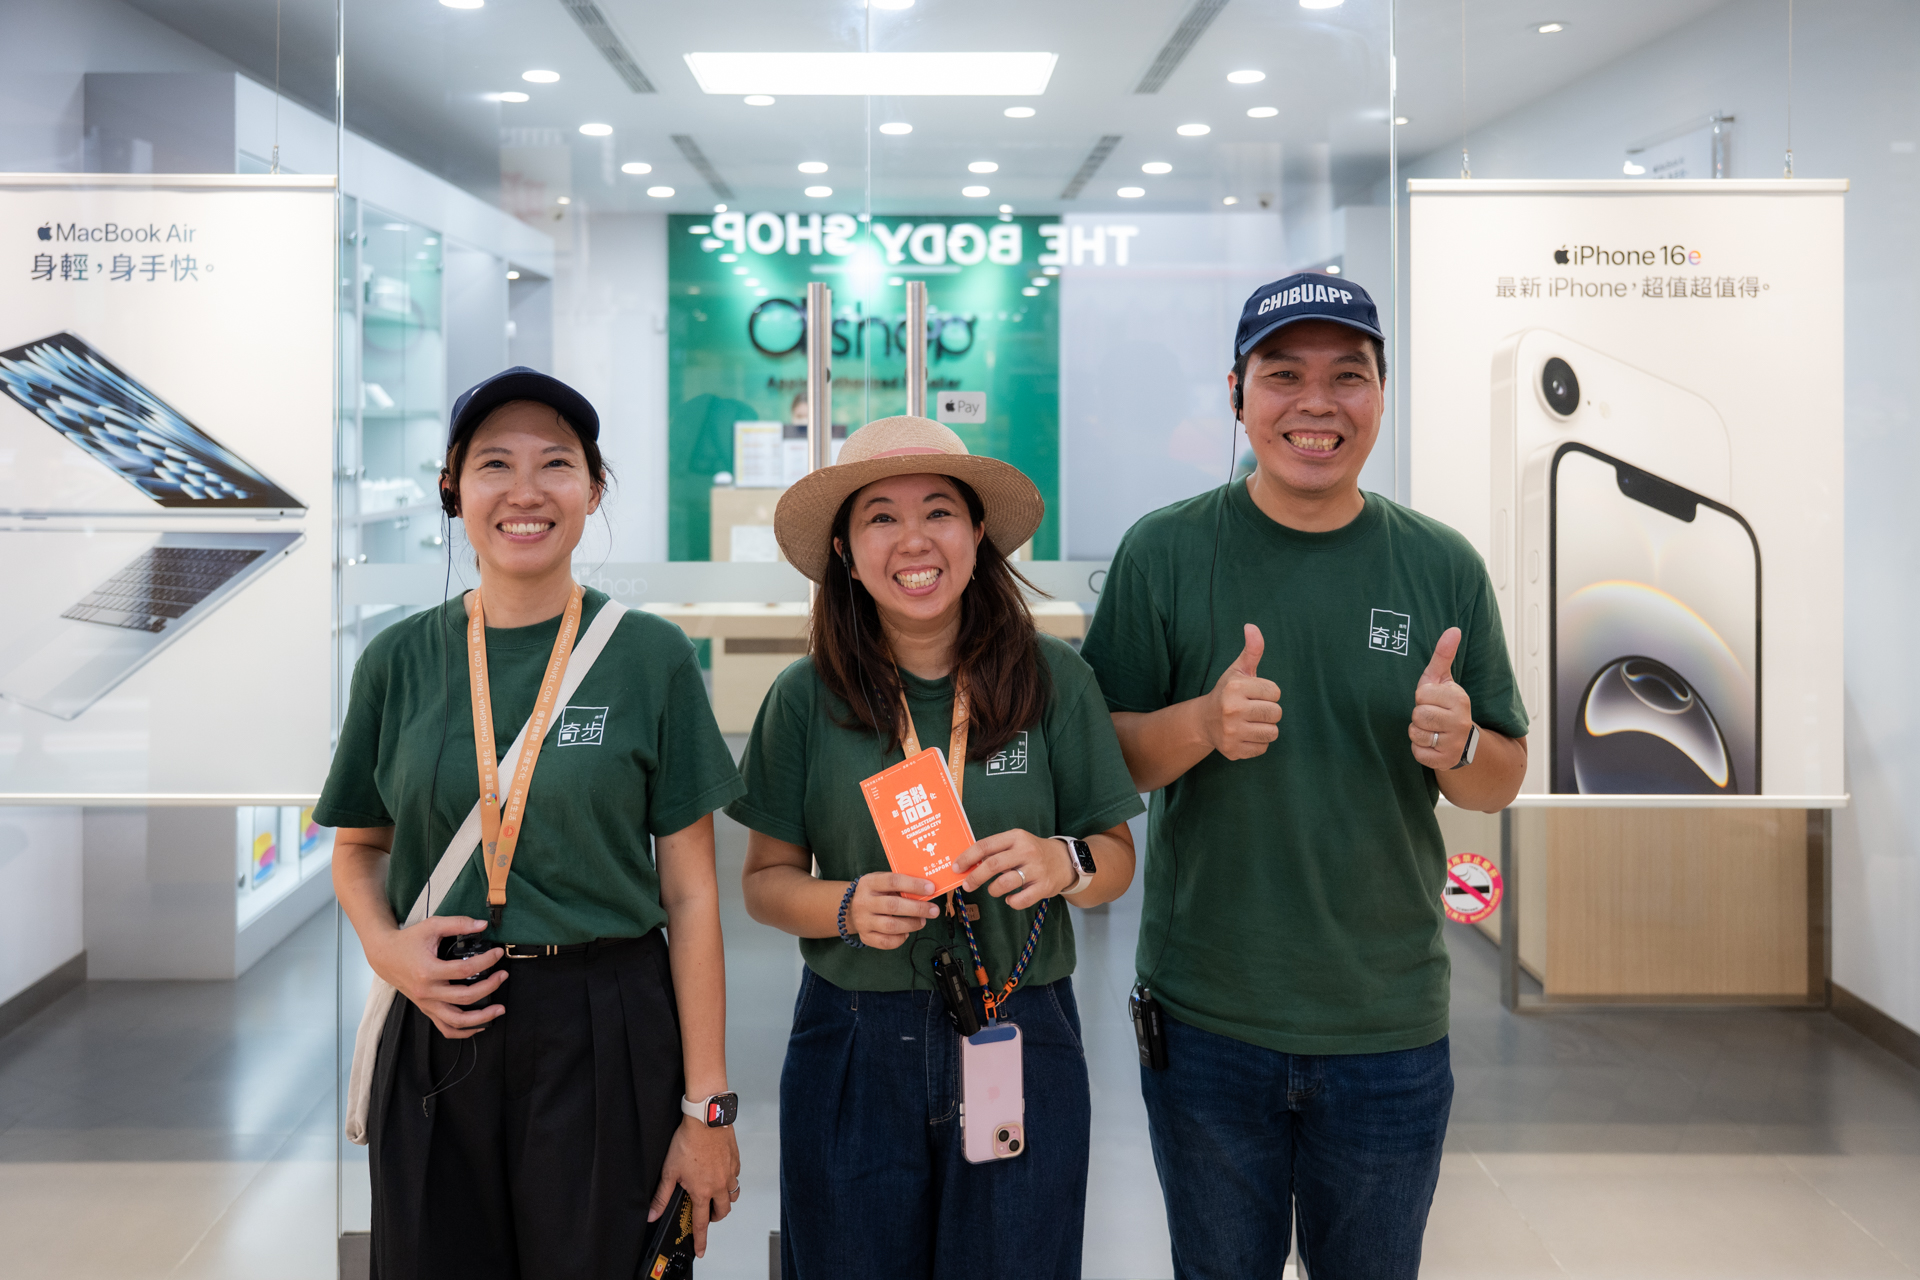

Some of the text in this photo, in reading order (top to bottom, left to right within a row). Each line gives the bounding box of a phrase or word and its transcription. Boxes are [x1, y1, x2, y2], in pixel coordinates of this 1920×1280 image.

[56, 223, 197, 242] MacBook Air
[1574, 245, 1702, 265] iPhone 16e
[31, 253, 215, 281] 身輕，身手快。
[1495, 276, 1542, 298] 最新
[1257, 283, 1353, 315] CHIBUAPP
[957, 400, 980, 416] Pay
[1372, 627, 1407, 650] 奇步
[561, 721, 602, 742] 奇步
[901, 800, 933, 825] 100
[925, 860, 952, 877] PASSPORT
